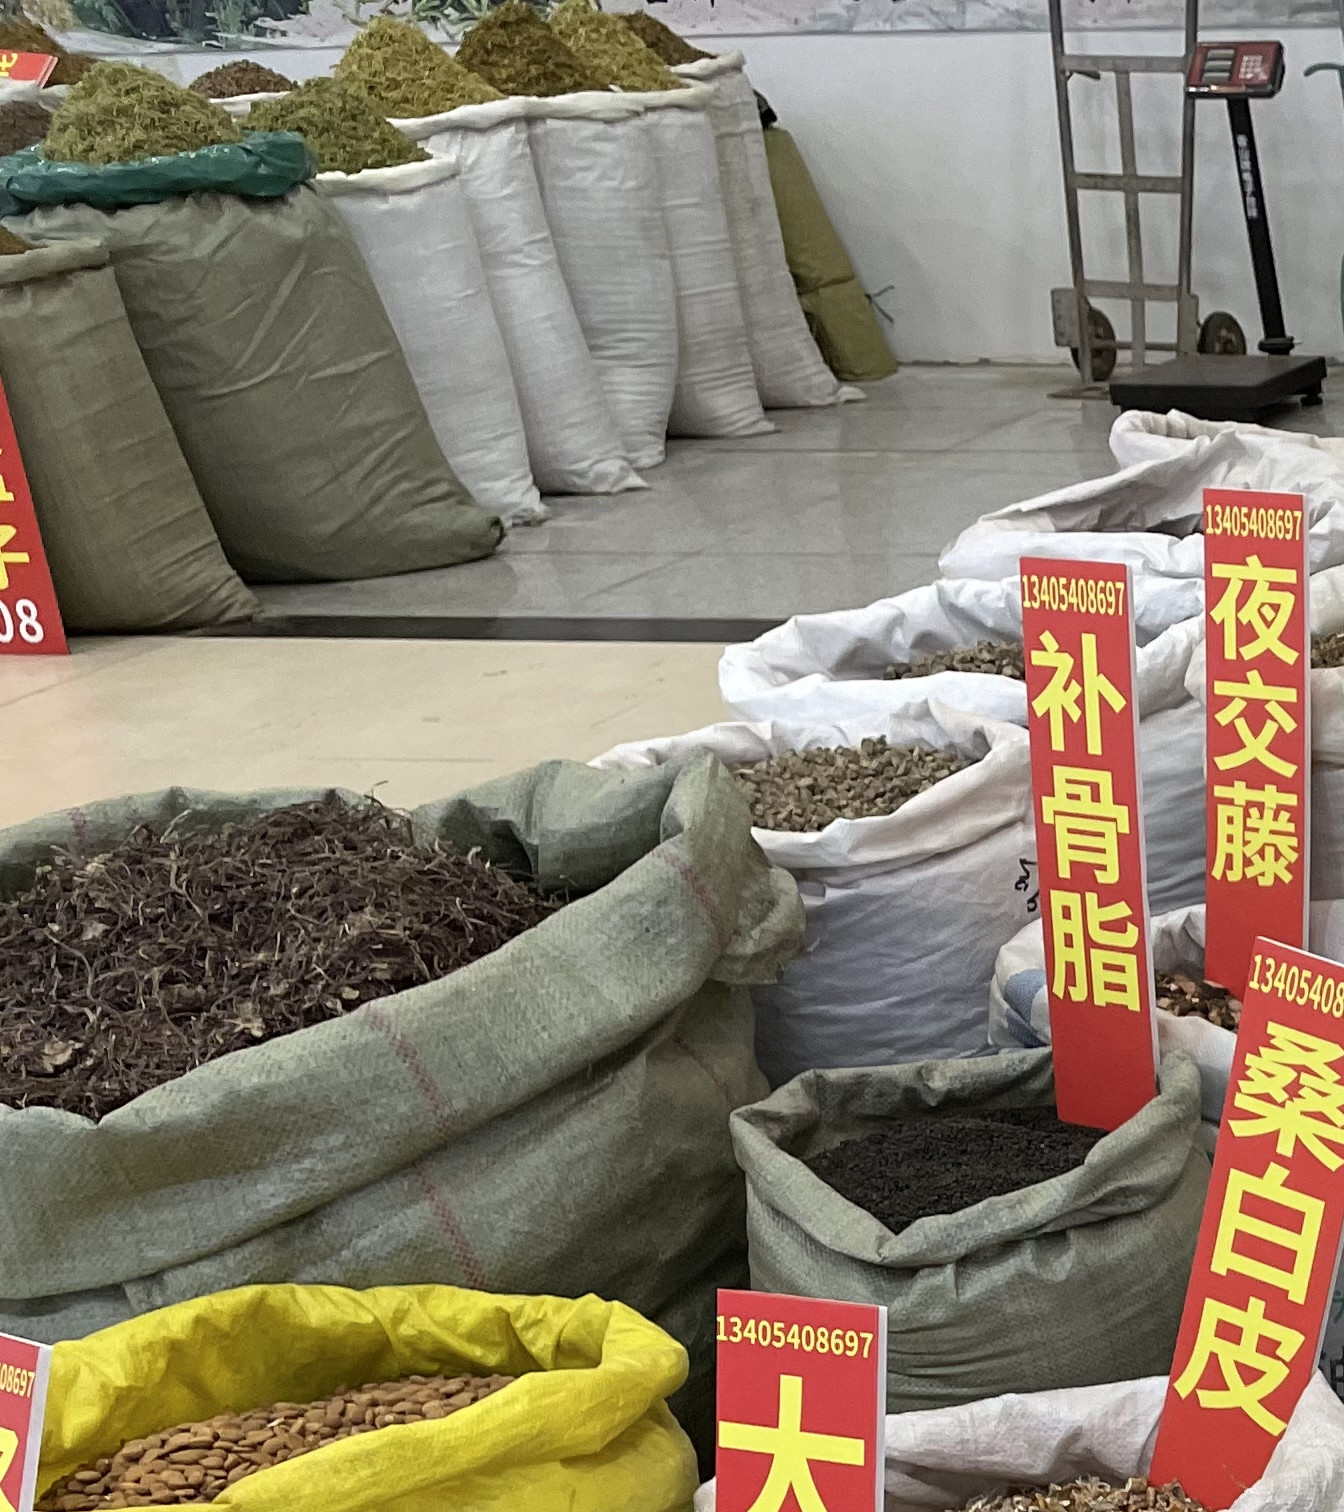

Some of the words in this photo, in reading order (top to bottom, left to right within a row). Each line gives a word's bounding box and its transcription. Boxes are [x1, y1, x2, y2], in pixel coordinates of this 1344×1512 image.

[1207, 506, 1302, 539] 13405408697
[1023, 576, 1124, 615] 13405408697
[1210, 555, 1298, 886] 夜交藤
[1031, 631, 1140, 1011] 补骨脂
[717, 1316, 872, 1357] 13405408697
[0, 1363, 35, 1398] 08697
